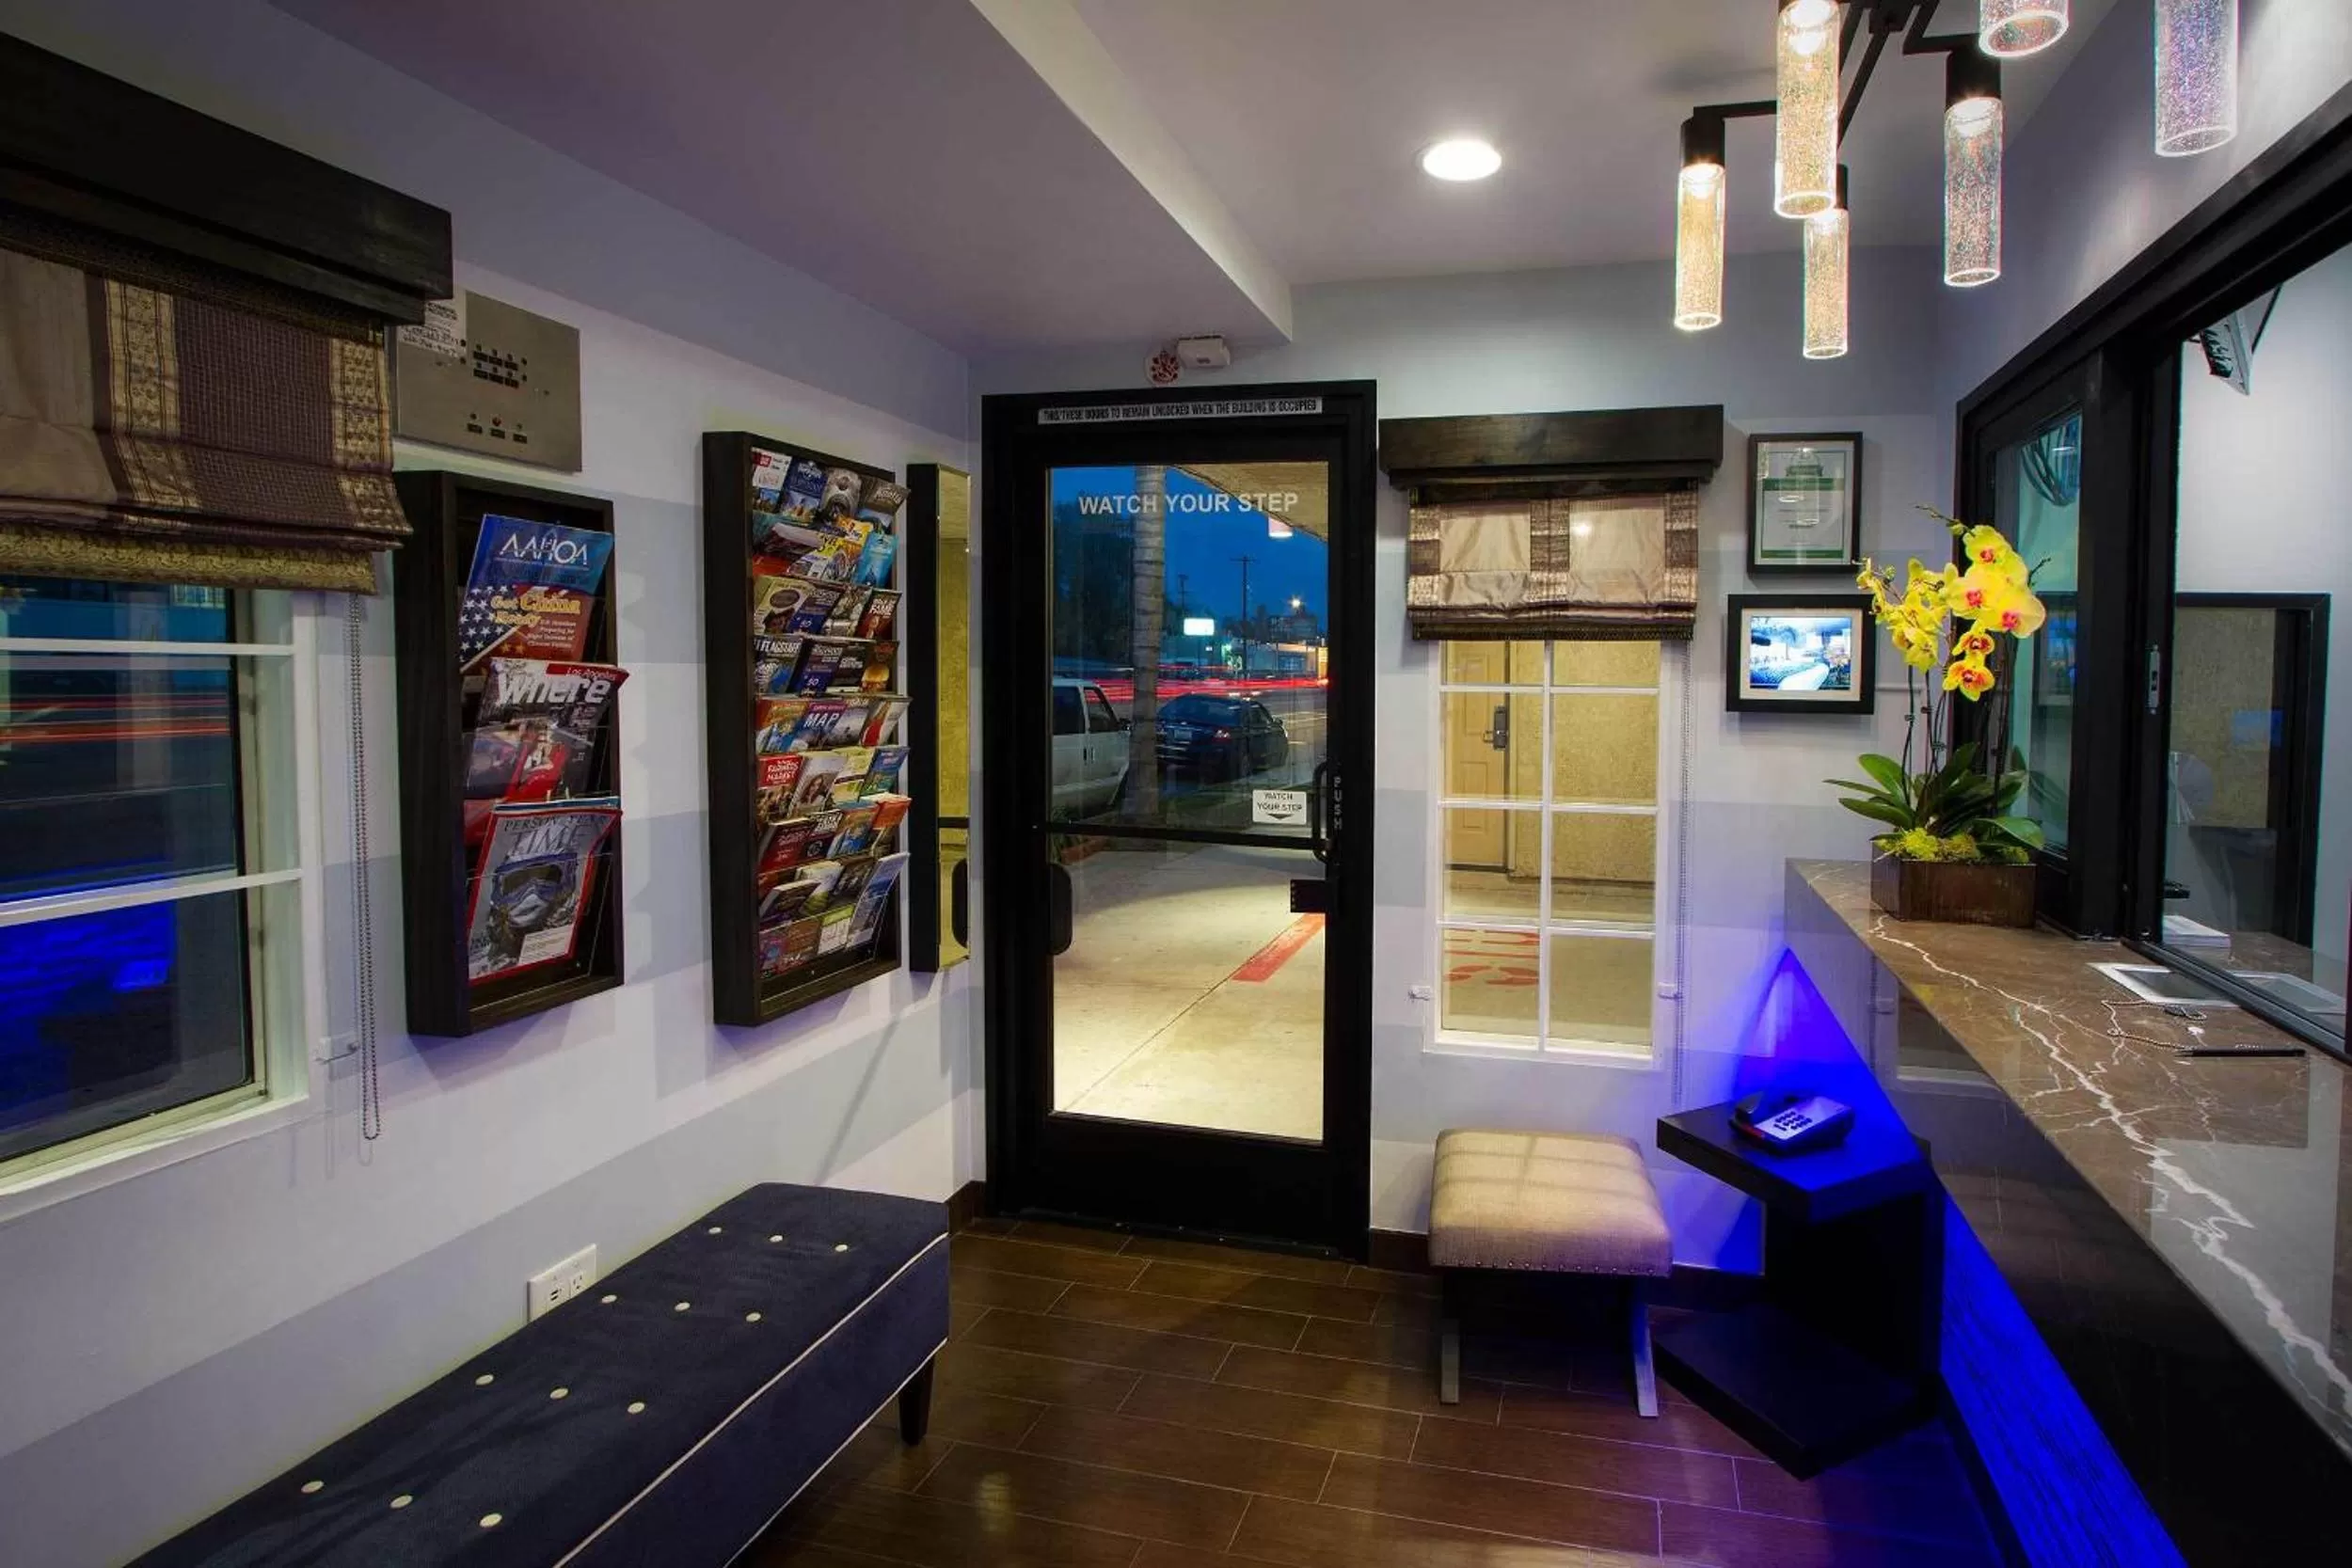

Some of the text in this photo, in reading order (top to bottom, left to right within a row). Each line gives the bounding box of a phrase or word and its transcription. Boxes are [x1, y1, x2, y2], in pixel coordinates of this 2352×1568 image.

[1111, 407, 1120, 420] TO
[1191, 404, 1213, 416] WHEN
[1216, 403, 1231, 415] THE
[1232, 401, 1266, 414] BUILDING
[1270, 400, 1277, 413] IS
[1279, 398, 1316, 413] OCCUPIED
[1078, 492, 1299, 515] WATCH YOUR STEP
[500, 531, 588, 565] AAHOA
[803, 712, 841, 729] MAP
[1257, 801, 1303, 812] YOUR STEP
[1264, 792, 1294, 800] WATCH
[509, 825, 591, 856] TIME
